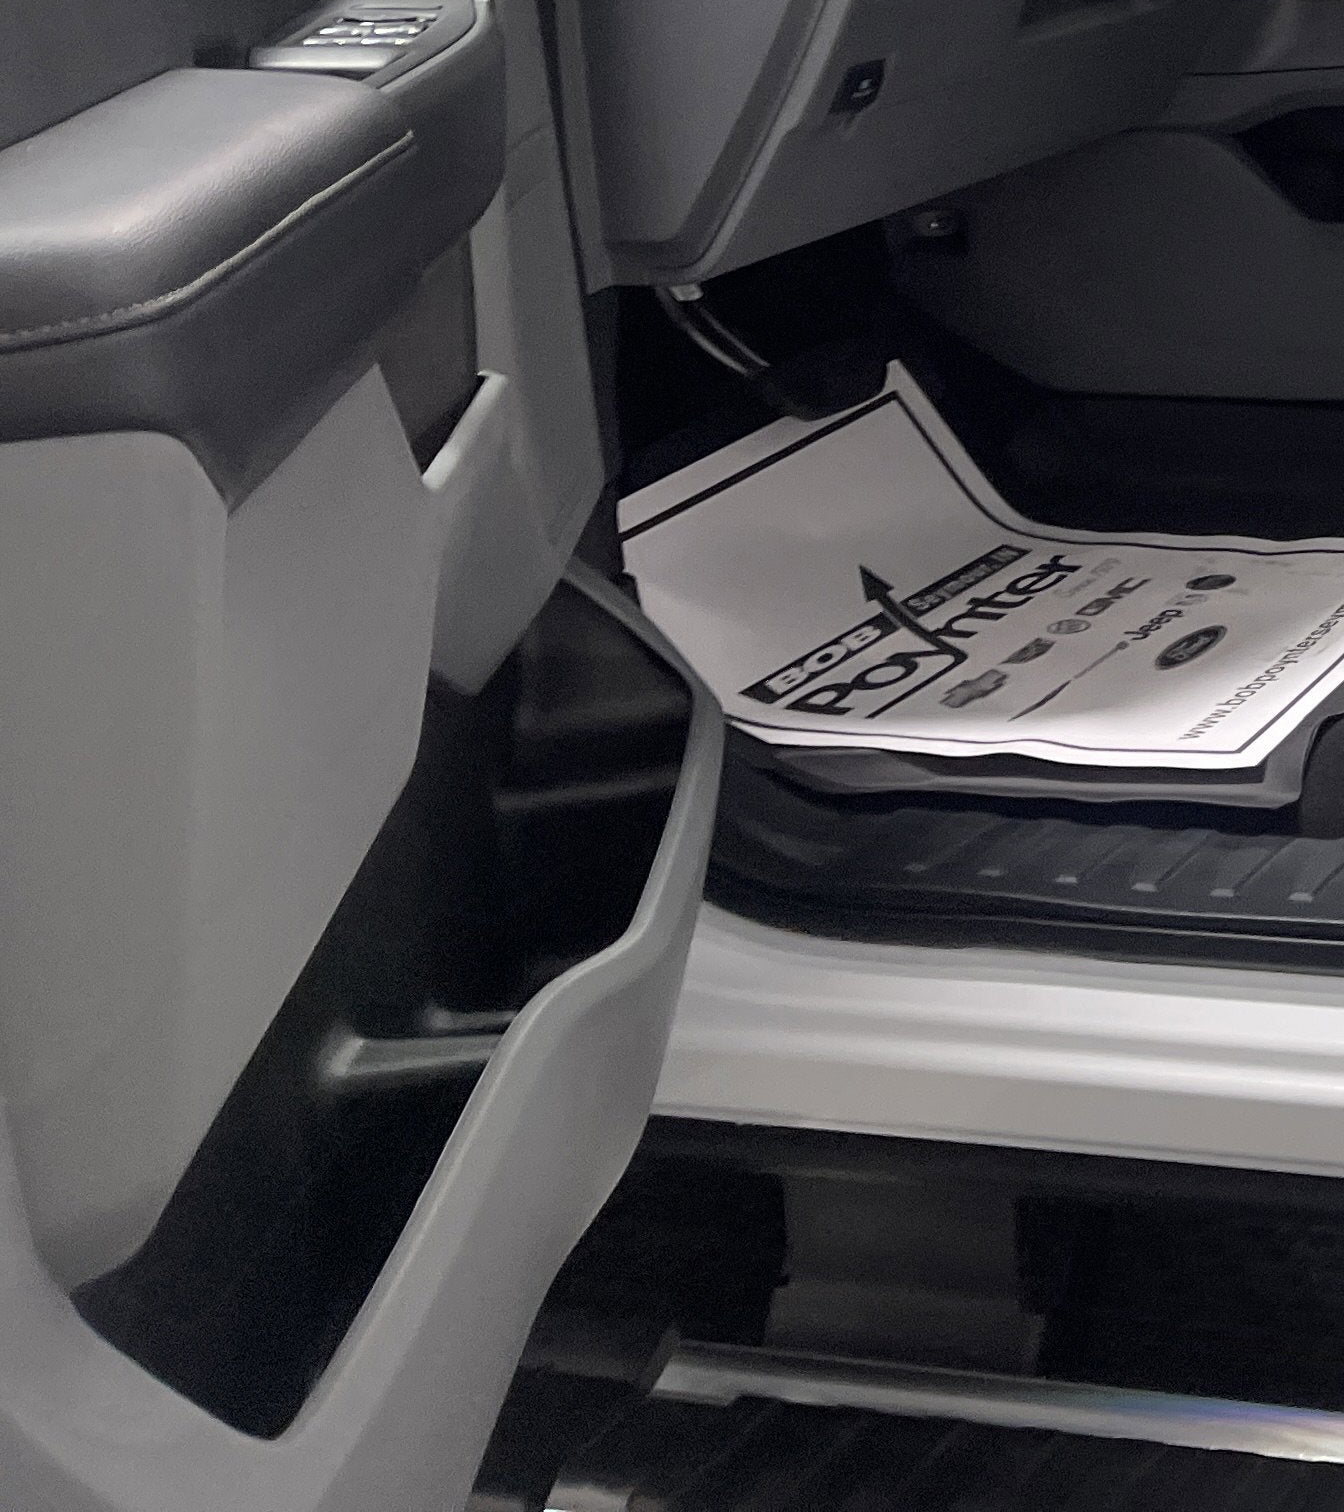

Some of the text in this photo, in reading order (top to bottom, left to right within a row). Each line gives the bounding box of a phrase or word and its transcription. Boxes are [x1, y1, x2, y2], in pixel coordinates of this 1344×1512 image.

[764, 624, 884, 696] BOB
[785, 554, 1083, 719] Poynter
[1124, 608, 1184, 641] Jeep
